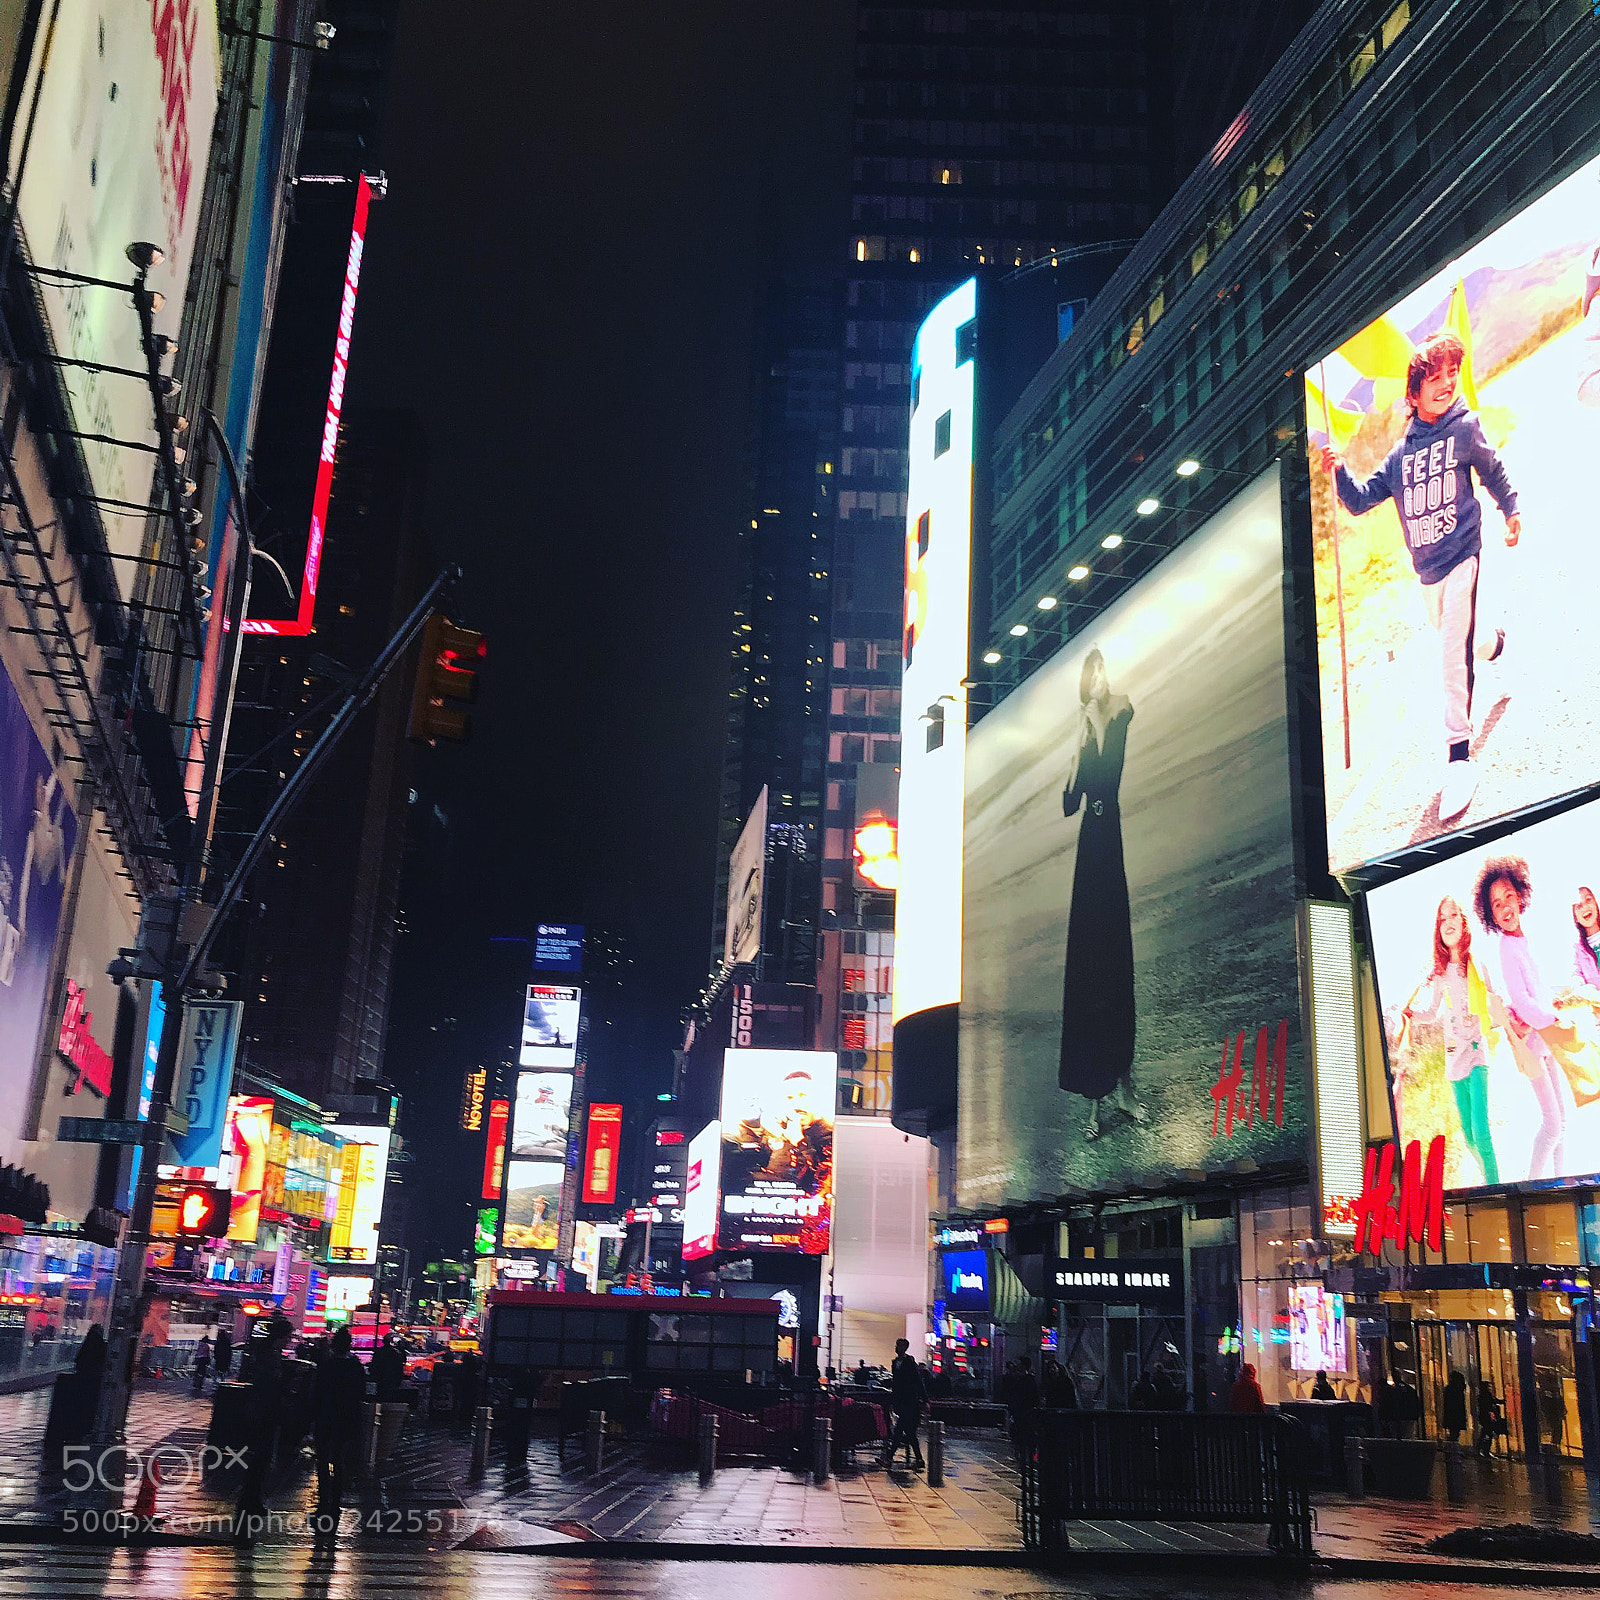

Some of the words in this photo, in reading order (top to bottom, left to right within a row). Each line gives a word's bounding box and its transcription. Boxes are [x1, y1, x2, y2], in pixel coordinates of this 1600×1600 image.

[1402, 436, 1458, 485] FEEL
[1403, 469, 1457, 517] GOOD
[1406, 504, 1457, 548] VIBES
[737, 984, 752, 1047] 1500
[185, 1009, 217, 1124] NYPD
[1210, 1018, 1289, 1138] H&M
[467, 1069, 486, 1131] NOVOTEL
[1352, 1135, 1446, 1257] H&M
[1056, 1272, 1118, 1286] SHARPER
[1125, 1272, 1170, 1287] IMAGE
